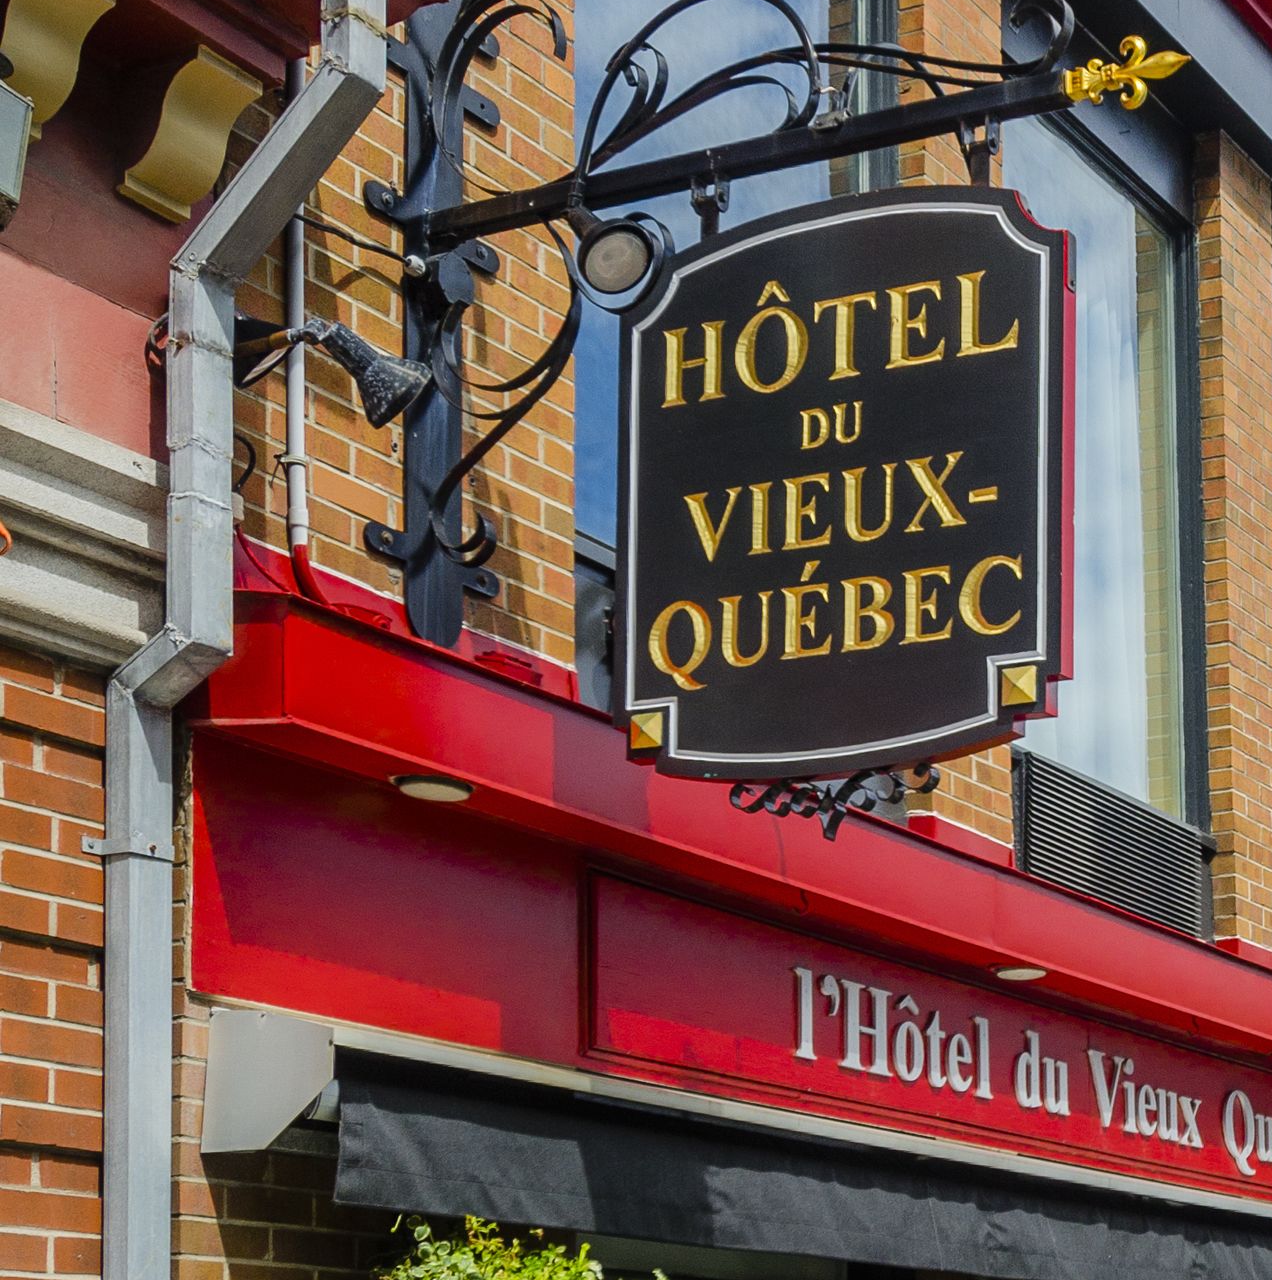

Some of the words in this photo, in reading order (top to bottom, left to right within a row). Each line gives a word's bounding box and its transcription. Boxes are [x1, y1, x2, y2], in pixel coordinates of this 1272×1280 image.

[661, 270, 1020, 408] HÔTEL
[799, 400, 864, 450] DU
[683, 450, 999, 562] VIEUX-
[648, 553, 1023, 691] QUÉBEC
[793, 967, 993, 1100] l'Hôtel
[1015, 1031, 1071, 1117] du
[1087, 1049, 1203, 1148] Vieux
